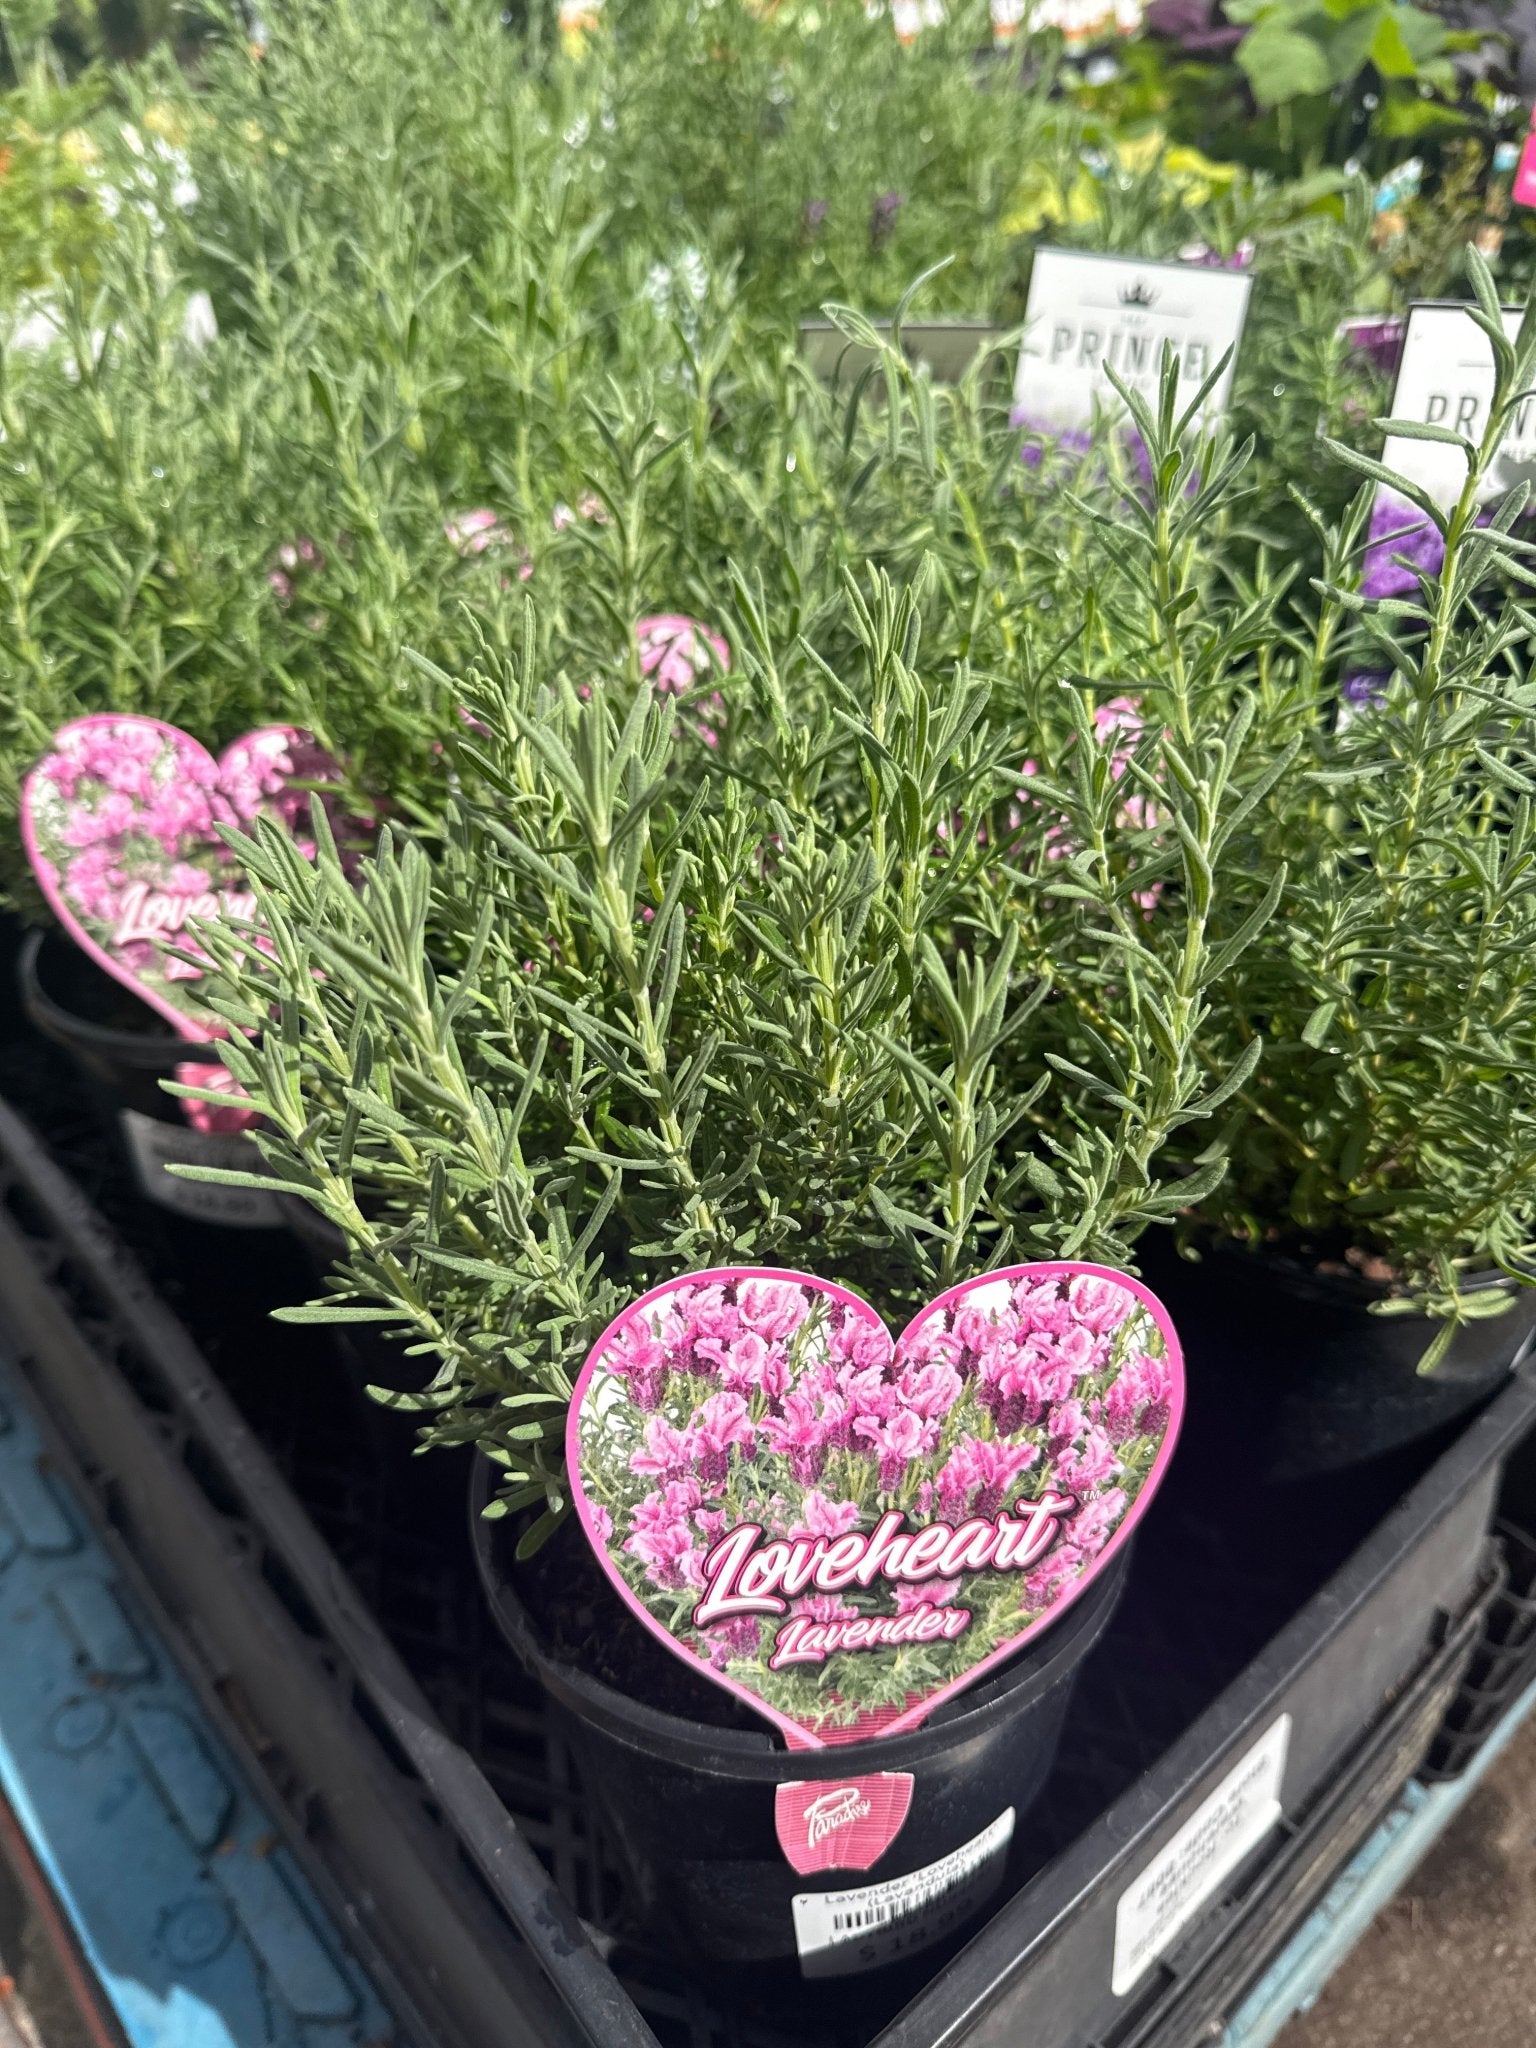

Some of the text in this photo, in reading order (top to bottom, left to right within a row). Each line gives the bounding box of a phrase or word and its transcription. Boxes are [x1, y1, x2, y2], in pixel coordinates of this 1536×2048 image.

[694, 1492, 1076, 1627] Loveheart
[768, 1602, 970, 1670] Lavender
[803, 1787, 871, 1849] Paradise
[825, 1880, 908, 1904] Lavender
